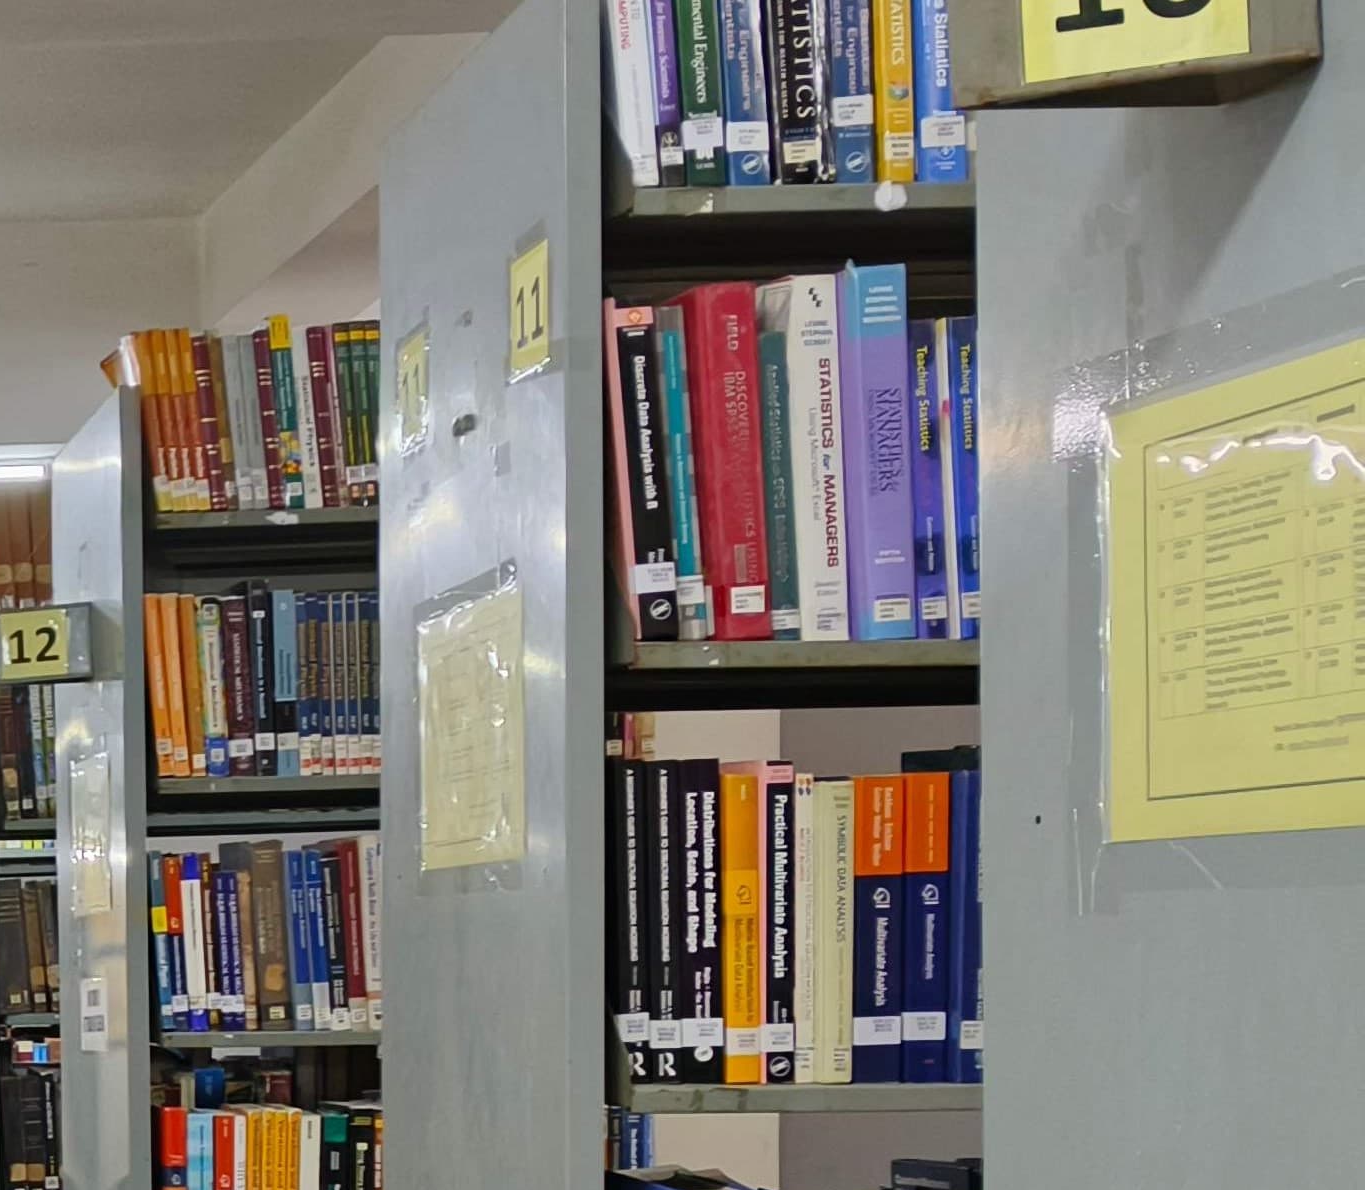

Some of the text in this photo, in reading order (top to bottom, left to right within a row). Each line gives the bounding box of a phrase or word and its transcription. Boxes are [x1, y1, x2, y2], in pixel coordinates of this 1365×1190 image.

[659, 55, 671, 99] Scientists
[691, 44, 708, 104] Engineers
[738, 30, 751, 110] Engineers
[934, 13, 950, 87] Statistics
[516, 276, 544, 349] 11
[726, 315, 739, 351] FIELD
[633, 356, 648, 400] Discrete
[637, 402, 650, 427] Data
[915, 346, 931, 452] Teaching Statistics
[960, 344, 975, 449] Teaching Statistics
[305, 427, 316, 468] Physics
[638, 429, 655, 474] Analysis
[808, 407, 823, 521] Using Excel
[819, 358, 840, 568] STATISTICS for MANAGERS
[876, 389, 894, 492] MANAGERS
[889, 388, 904, 477] STATISTICS
[644, 475, 657, 500] with
[7, 626, 60, 665] 12
[685, 791, 699, 953] Location, Scale, and Shape
[702, 791, 716, 947] Distributions for Modeling
[772, 794, 788, 978] Practical Multivariate Analysis
[836, 815, 847, 943] SYMBOLIC DATA ANALYSIS
[874, 917, 888, 1007] Multivariate Analysis
[658, 1052, 677, 1077] R
